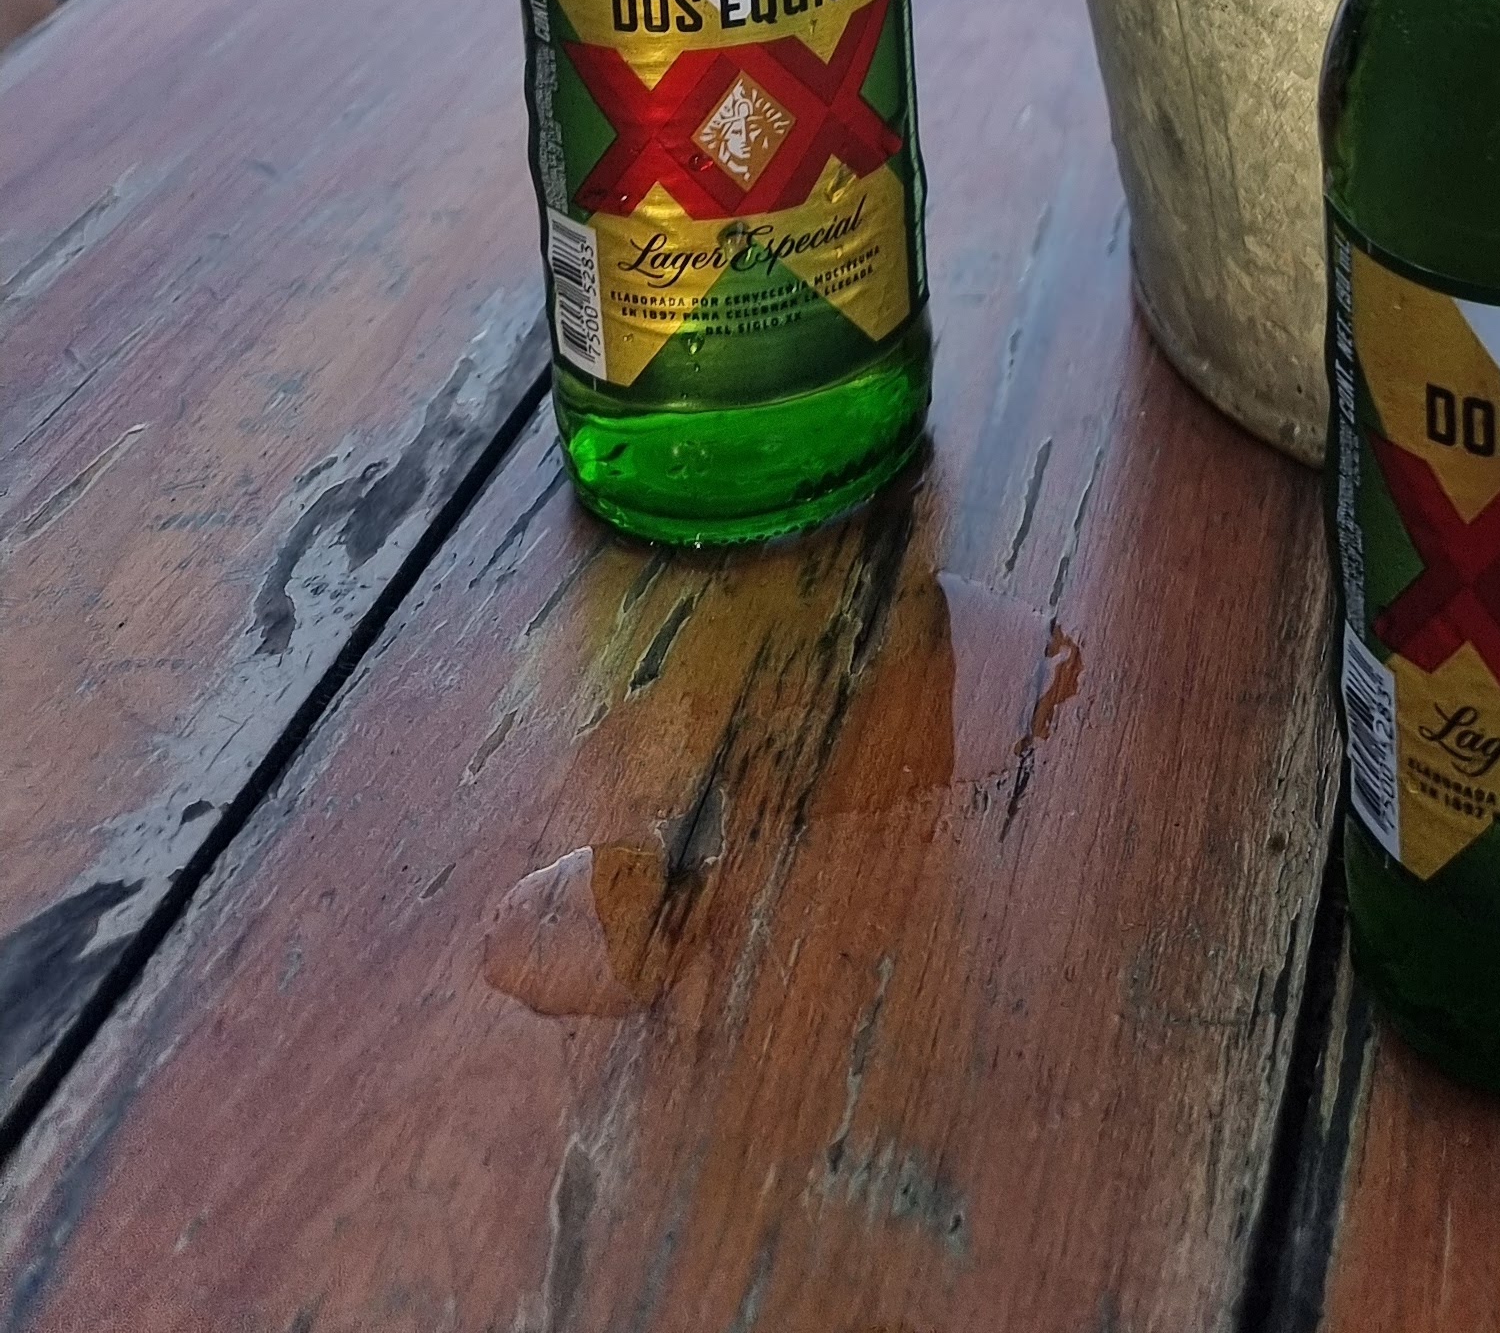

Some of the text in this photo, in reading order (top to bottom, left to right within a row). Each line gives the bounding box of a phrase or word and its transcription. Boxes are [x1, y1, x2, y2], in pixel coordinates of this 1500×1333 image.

[618, 193, 868, 288] Lager Especial
[580, 244, 601, 356] 7500 5283
[610, 291, 685, 308] ELABORADA
[691, 296, 719, 307] POR
[621, 307, 640, 317] EN
